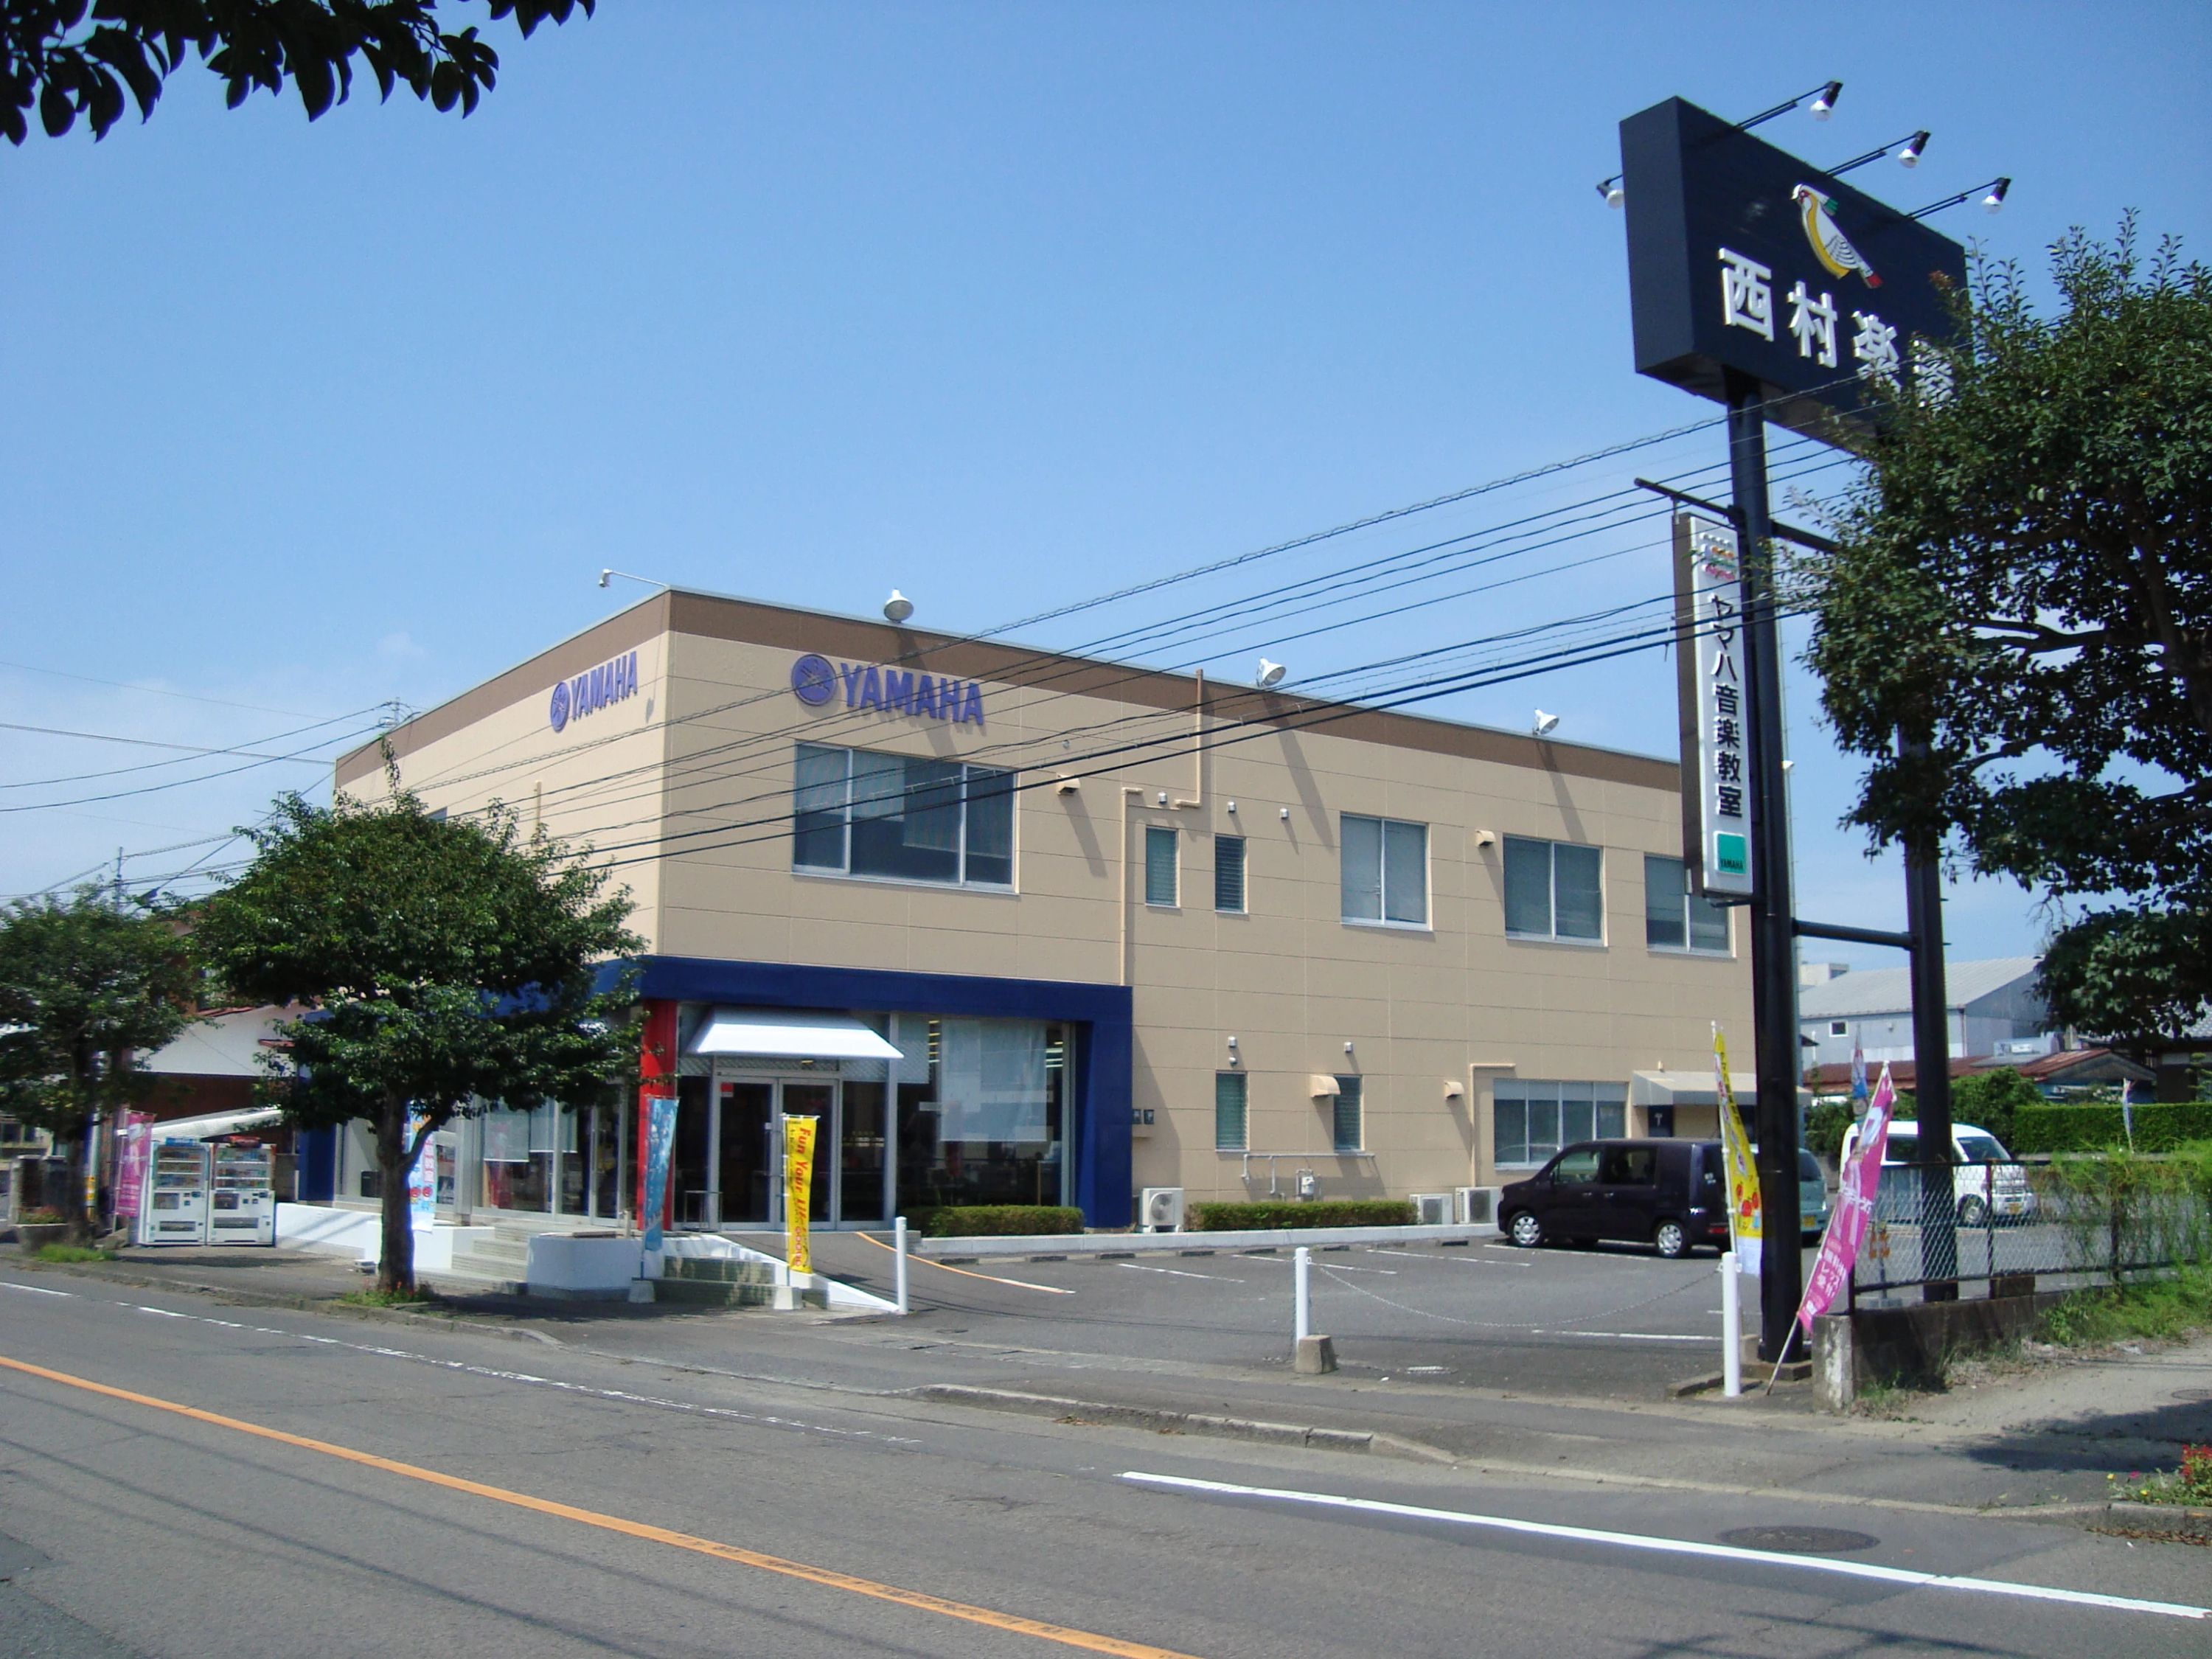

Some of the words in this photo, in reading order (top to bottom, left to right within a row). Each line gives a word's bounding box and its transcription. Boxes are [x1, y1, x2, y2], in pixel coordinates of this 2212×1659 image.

[571, 650, 638, 722] YAMAHA
[841, 662, 984, 726] YAMAHA
[1711, 594, 1742, 818] ヤマハ音楽教室
[1719, 858, 1744, 870] YAMAHA
[796, 1127, 811, 1155] Fun
[795, 1161, 808, 1193] Your
